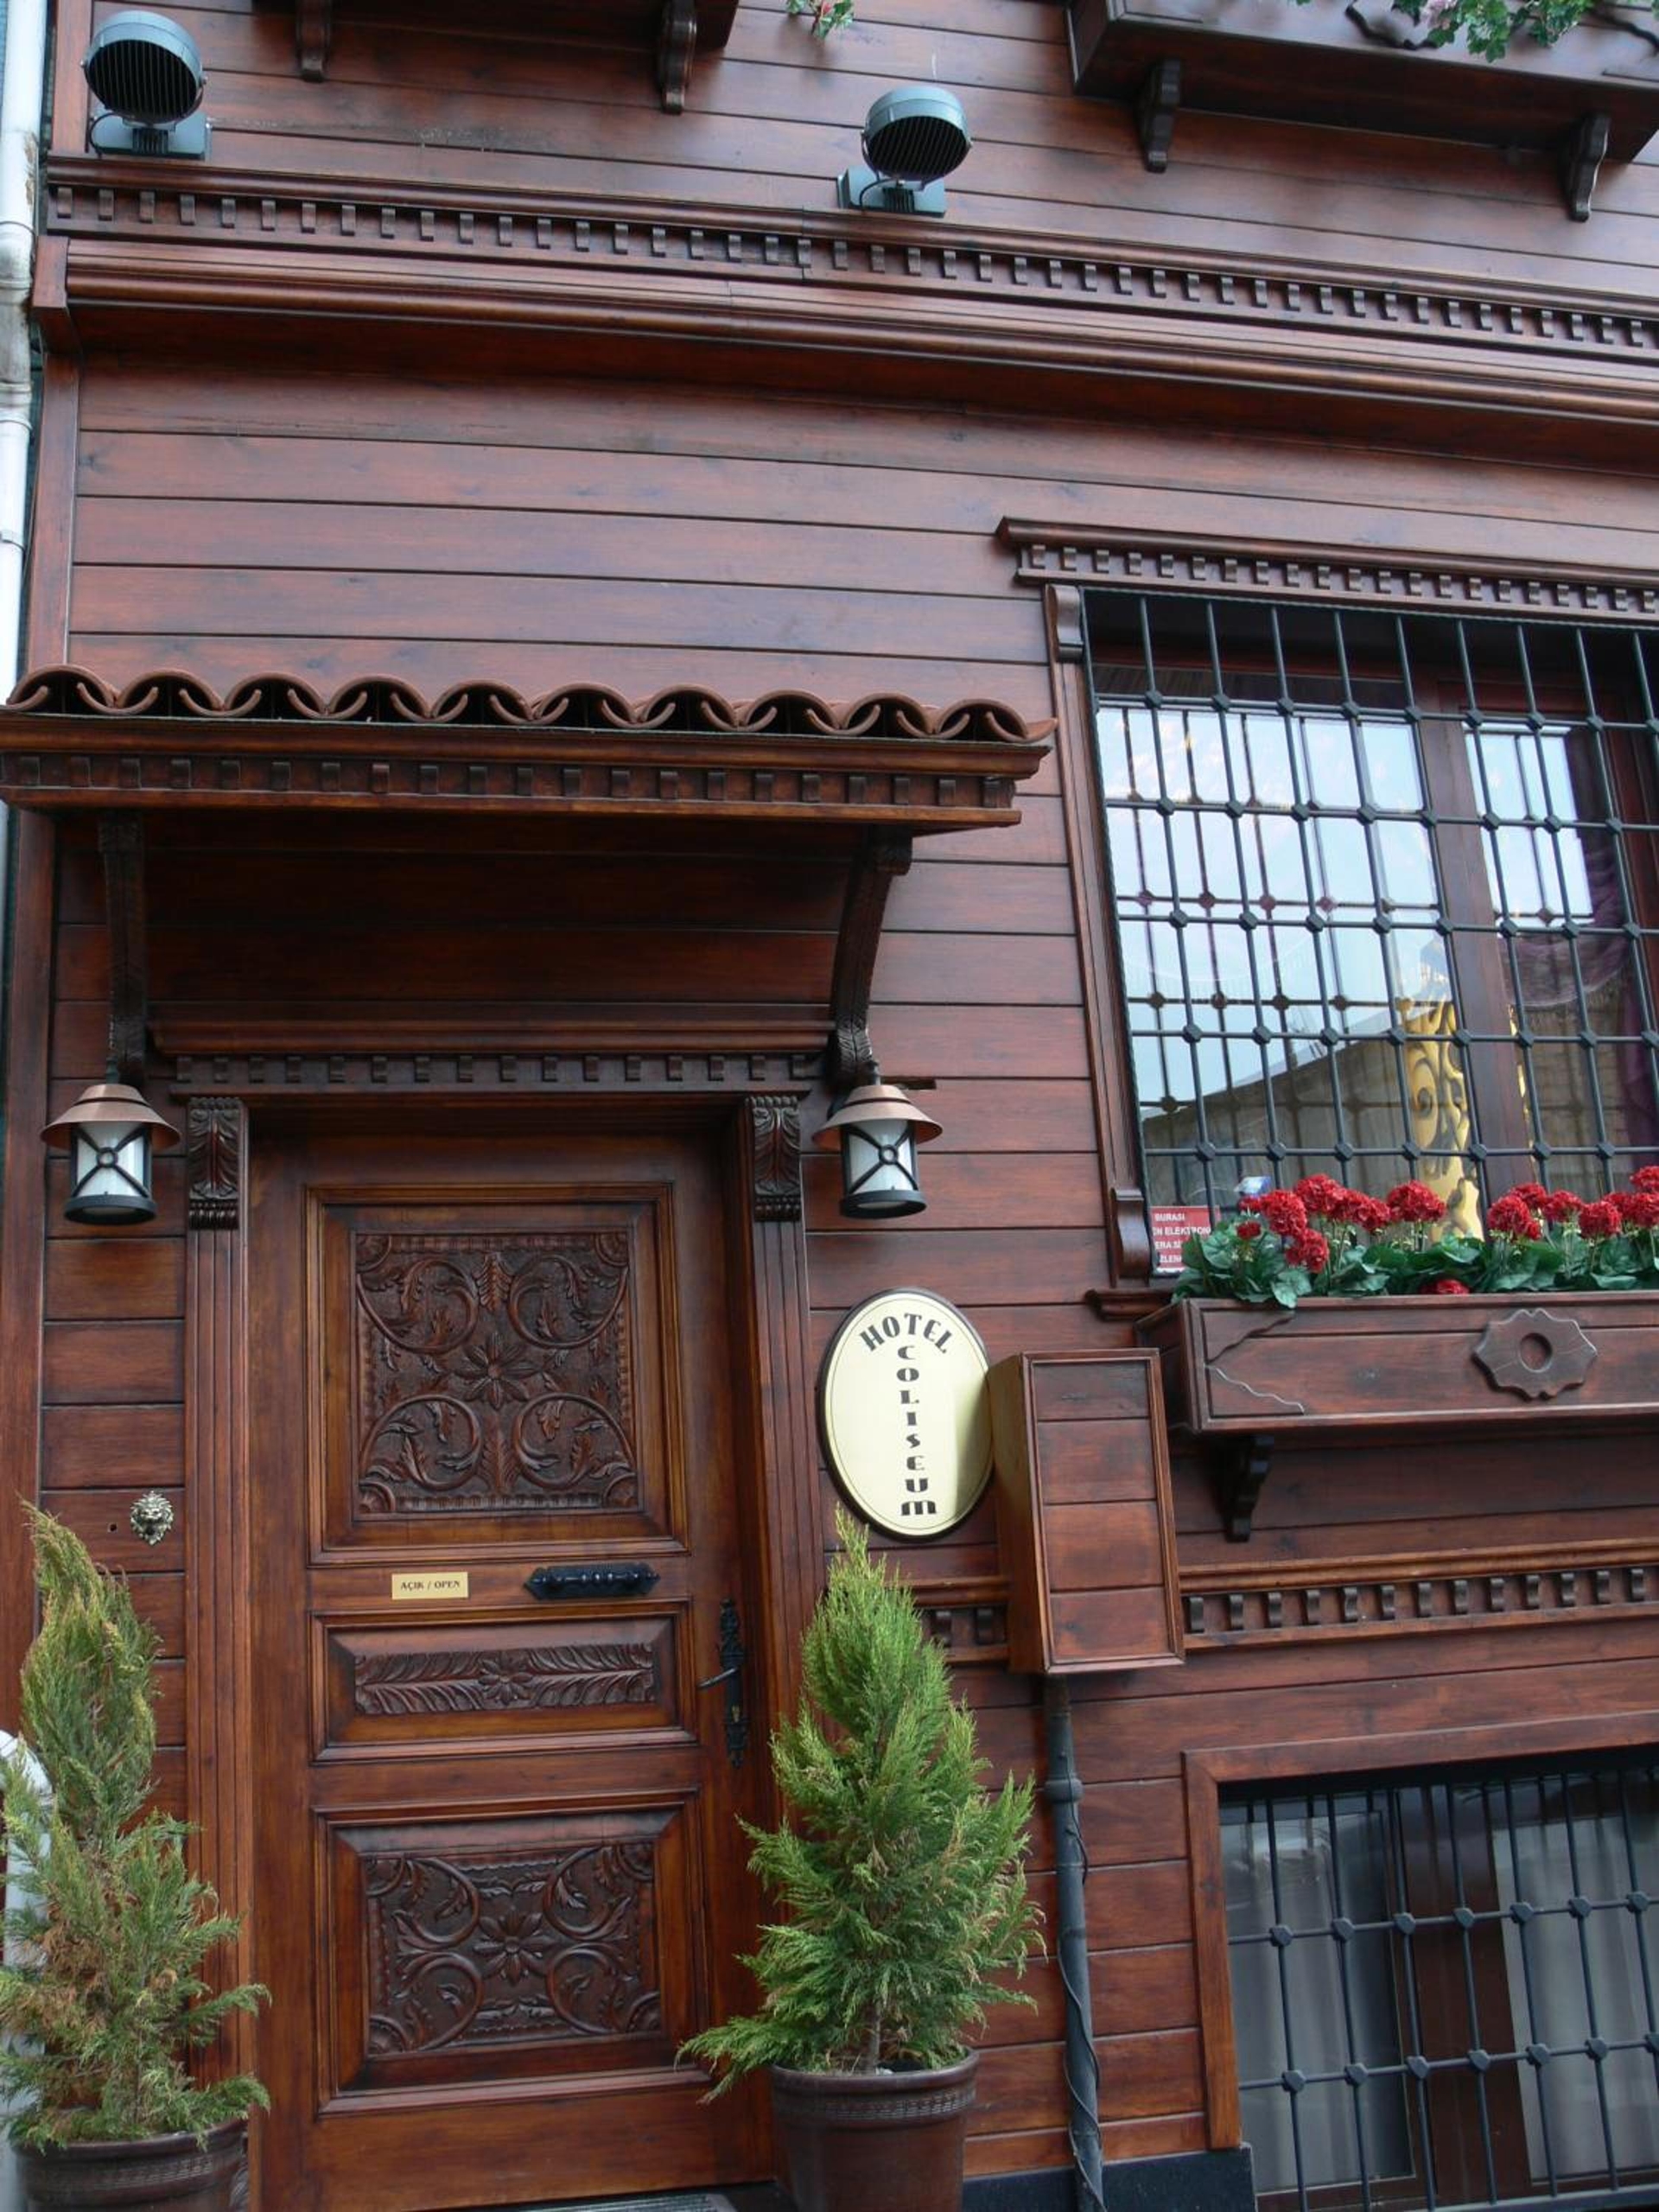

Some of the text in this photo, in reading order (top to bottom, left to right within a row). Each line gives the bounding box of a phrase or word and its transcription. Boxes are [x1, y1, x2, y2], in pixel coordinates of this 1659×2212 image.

[859, 1313, 953, 1354] HOTEL
[896, 1344, 938, 1516] COLISEUM
[401, 1581, 424, 1592] AÇIK
[434, 1580, 461, 1589] OPEN
